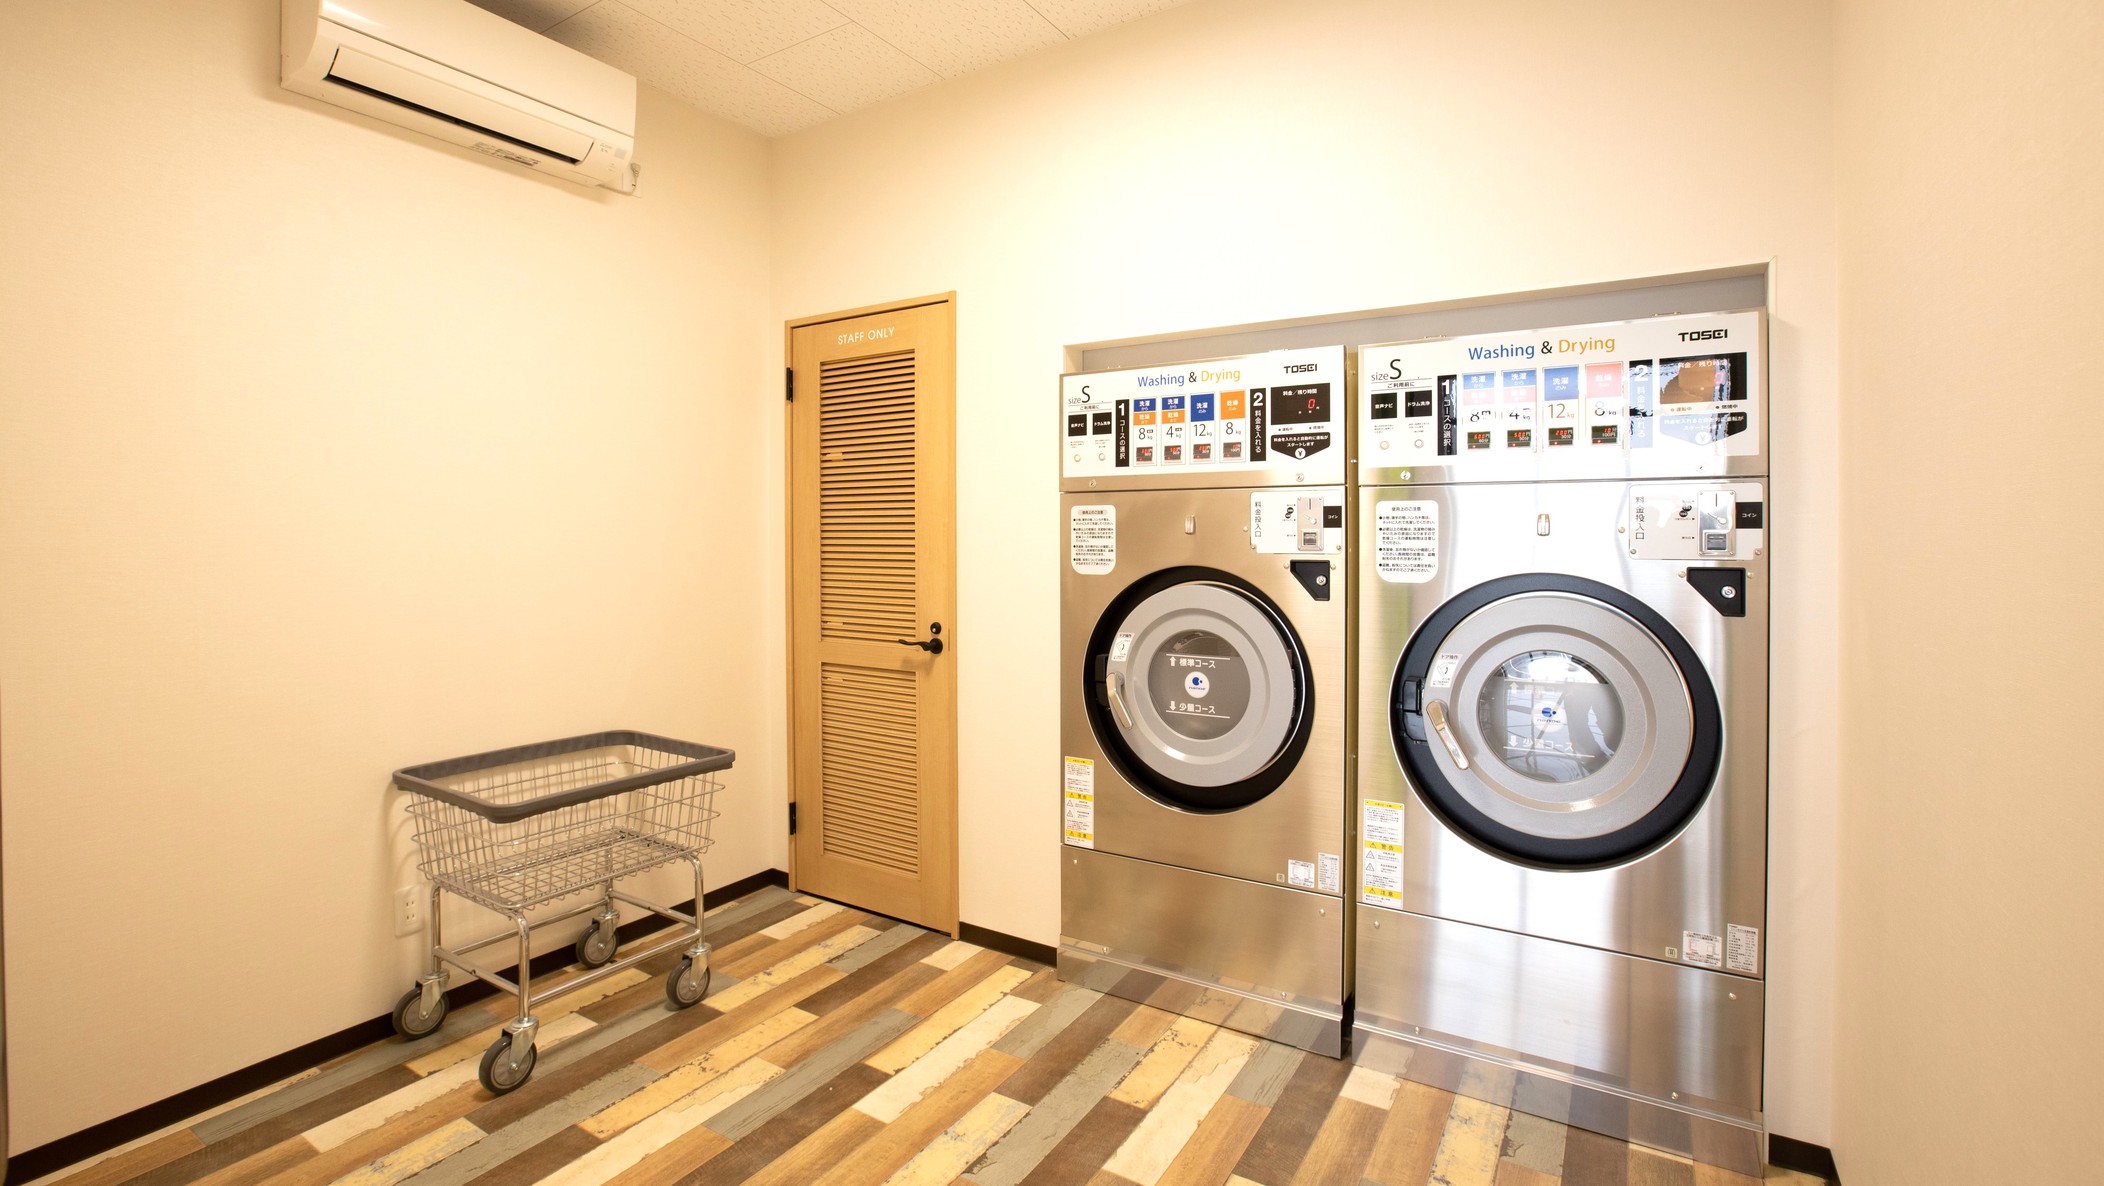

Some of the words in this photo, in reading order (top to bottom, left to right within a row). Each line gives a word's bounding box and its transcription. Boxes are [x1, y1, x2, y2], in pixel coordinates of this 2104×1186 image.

[838, 331, 864, 344] STAFF
[867, 326, 894, 340] ONLY
[1678, 328, 1728, 342] TOSEI
[1468, 343, 1535, 361] Washing
[1541, 340, 1553, 355] &
[1558, 337, 1616, 355] Drying
[1283, 363, 1318, 374] TOSEI
[1371, 372, 1389, 381] size
[1389, 358, 1402, 380] S
[1137, 374, 1185, 388] Washing
[1188, 371, 1198, 383] &
[1201, 369, 1241, 384] Drying
[1081, 385, 1091, 404] S
[1441, 379, 1450, 395] 1
[1252, 391, 1264, 406] 2
[1118, 402, 1125, 416] 1
[1547, 403, 1566, 419] 12
[1443, 399, 1452, 447] コースの選択
[1635, 496, 1645, 540] 料金投入口
[1179, 658, 1216, 669] 標準コース
[1179, 702, 1216, 714] 少量コース
